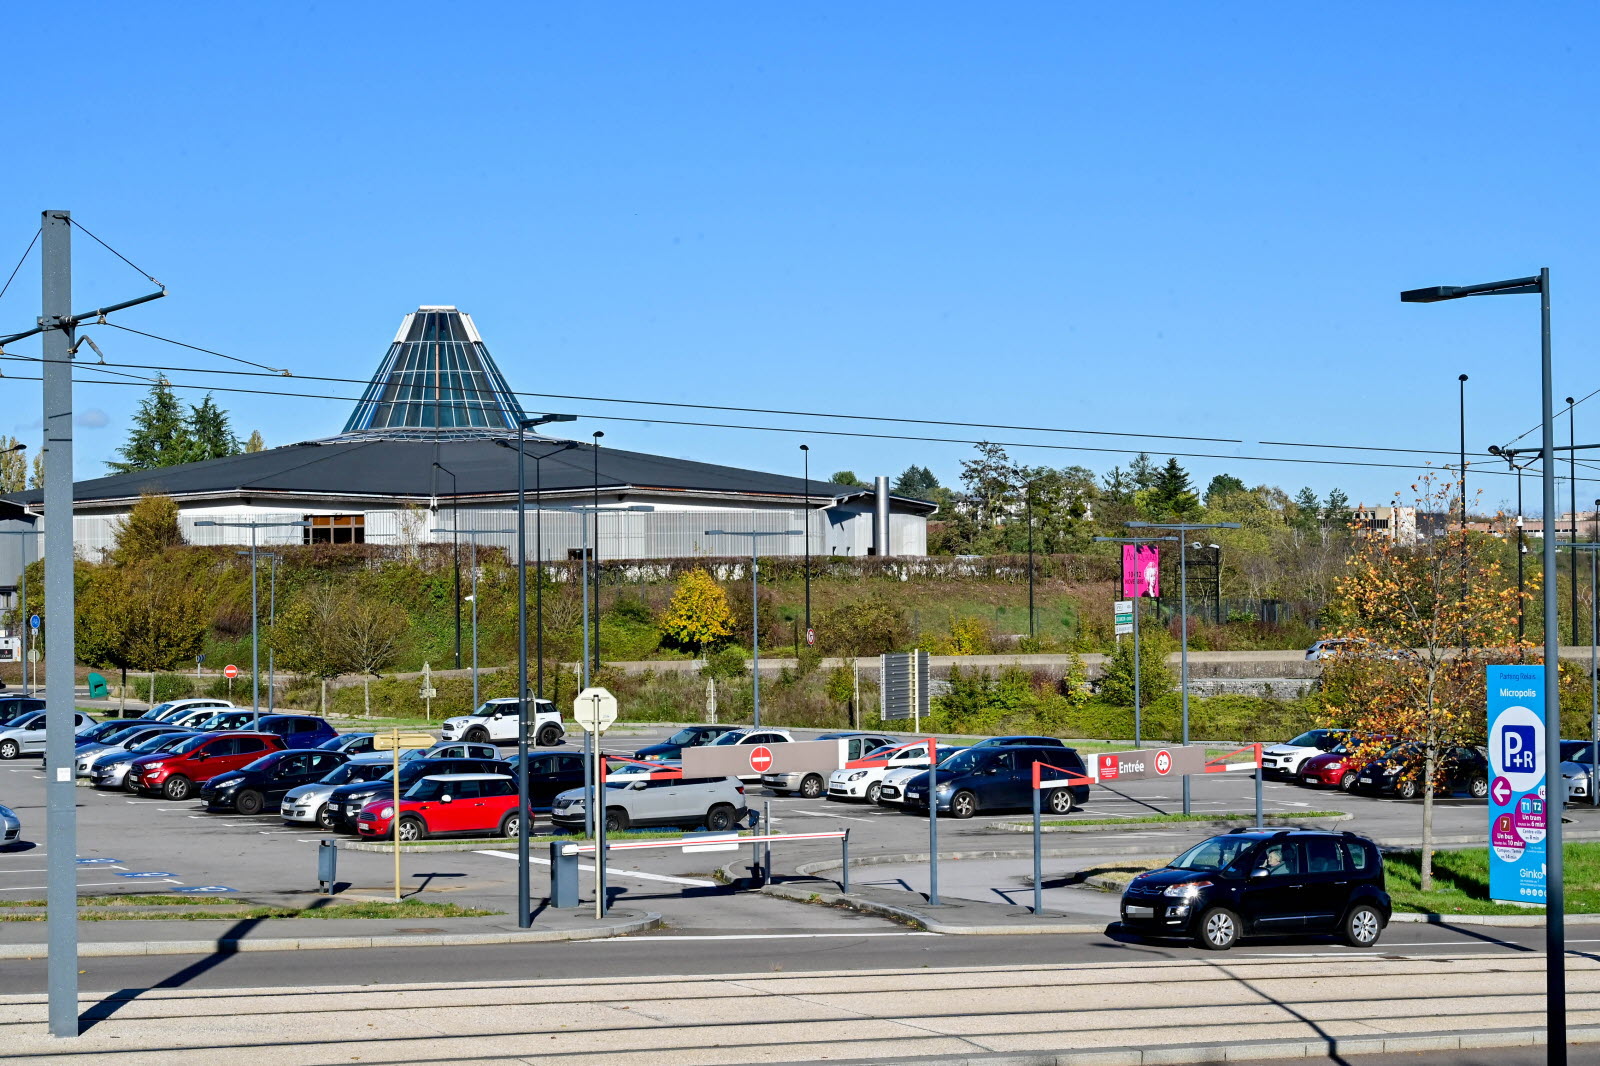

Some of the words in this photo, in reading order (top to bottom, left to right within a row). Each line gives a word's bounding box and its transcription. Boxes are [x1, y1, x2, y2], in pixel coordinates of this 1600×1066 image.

[1500, 688, 1536, 699] Micropolis
[1505, 732, 1533, 768] P+R
[1119, 760, 1145, 774] Entrée
[1522, 802, 1530, 811] T1
[1533, 802, 1542, 811] T2
[1502, 820, 1508, 828] 7
[1520, 868, 1543, 879] Ginko
